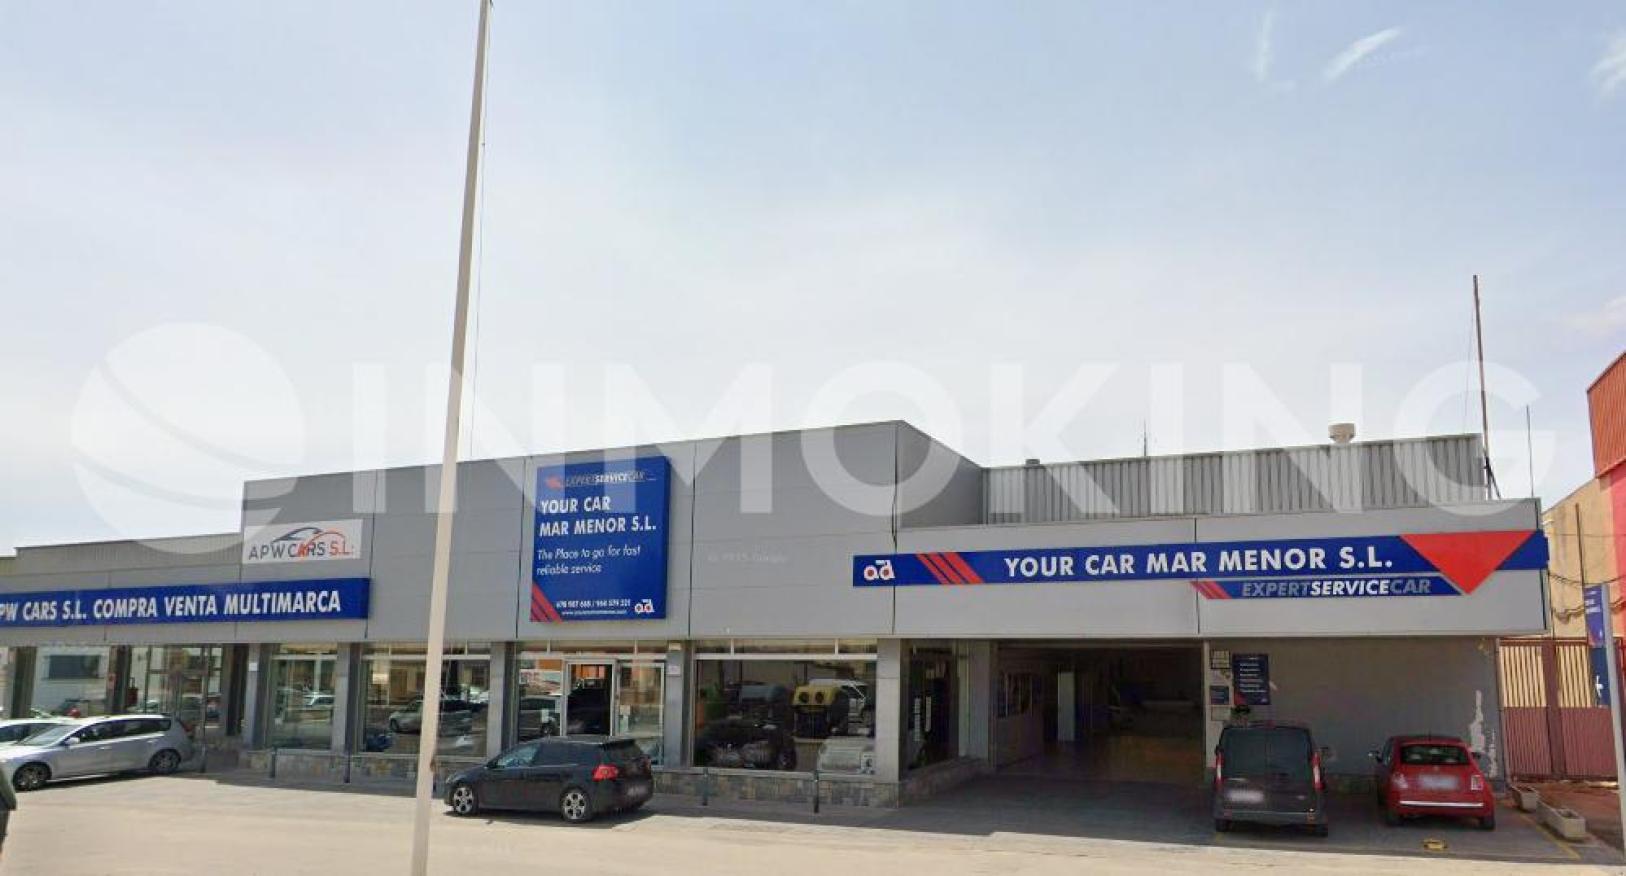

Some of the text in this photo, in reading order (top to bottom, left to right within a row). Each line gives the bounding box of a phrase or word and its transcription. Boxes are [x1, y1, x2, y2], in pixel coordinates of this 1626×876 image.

[541, 496, 611, 514] YOUR CAR
[540, 515, 657, 537] MAR MENOR S.L.
[538, 549, 553, 561] The
[608, 544, 621, 556] for
[623, 544, 641, 556] fast
[1004, 545, 1393, 578] YOUR CAR MAR MENOR S.L.
[536, 563, 602, 576] reliable service
[22, 601, 57, 621] CARS
[62, 600, 87, 620] S.L.
[93, 597, 157, 619] COMPRA
[164, 595, 217, 616] VENTA
[223, 589, 341, 615] MULTIMARCA
